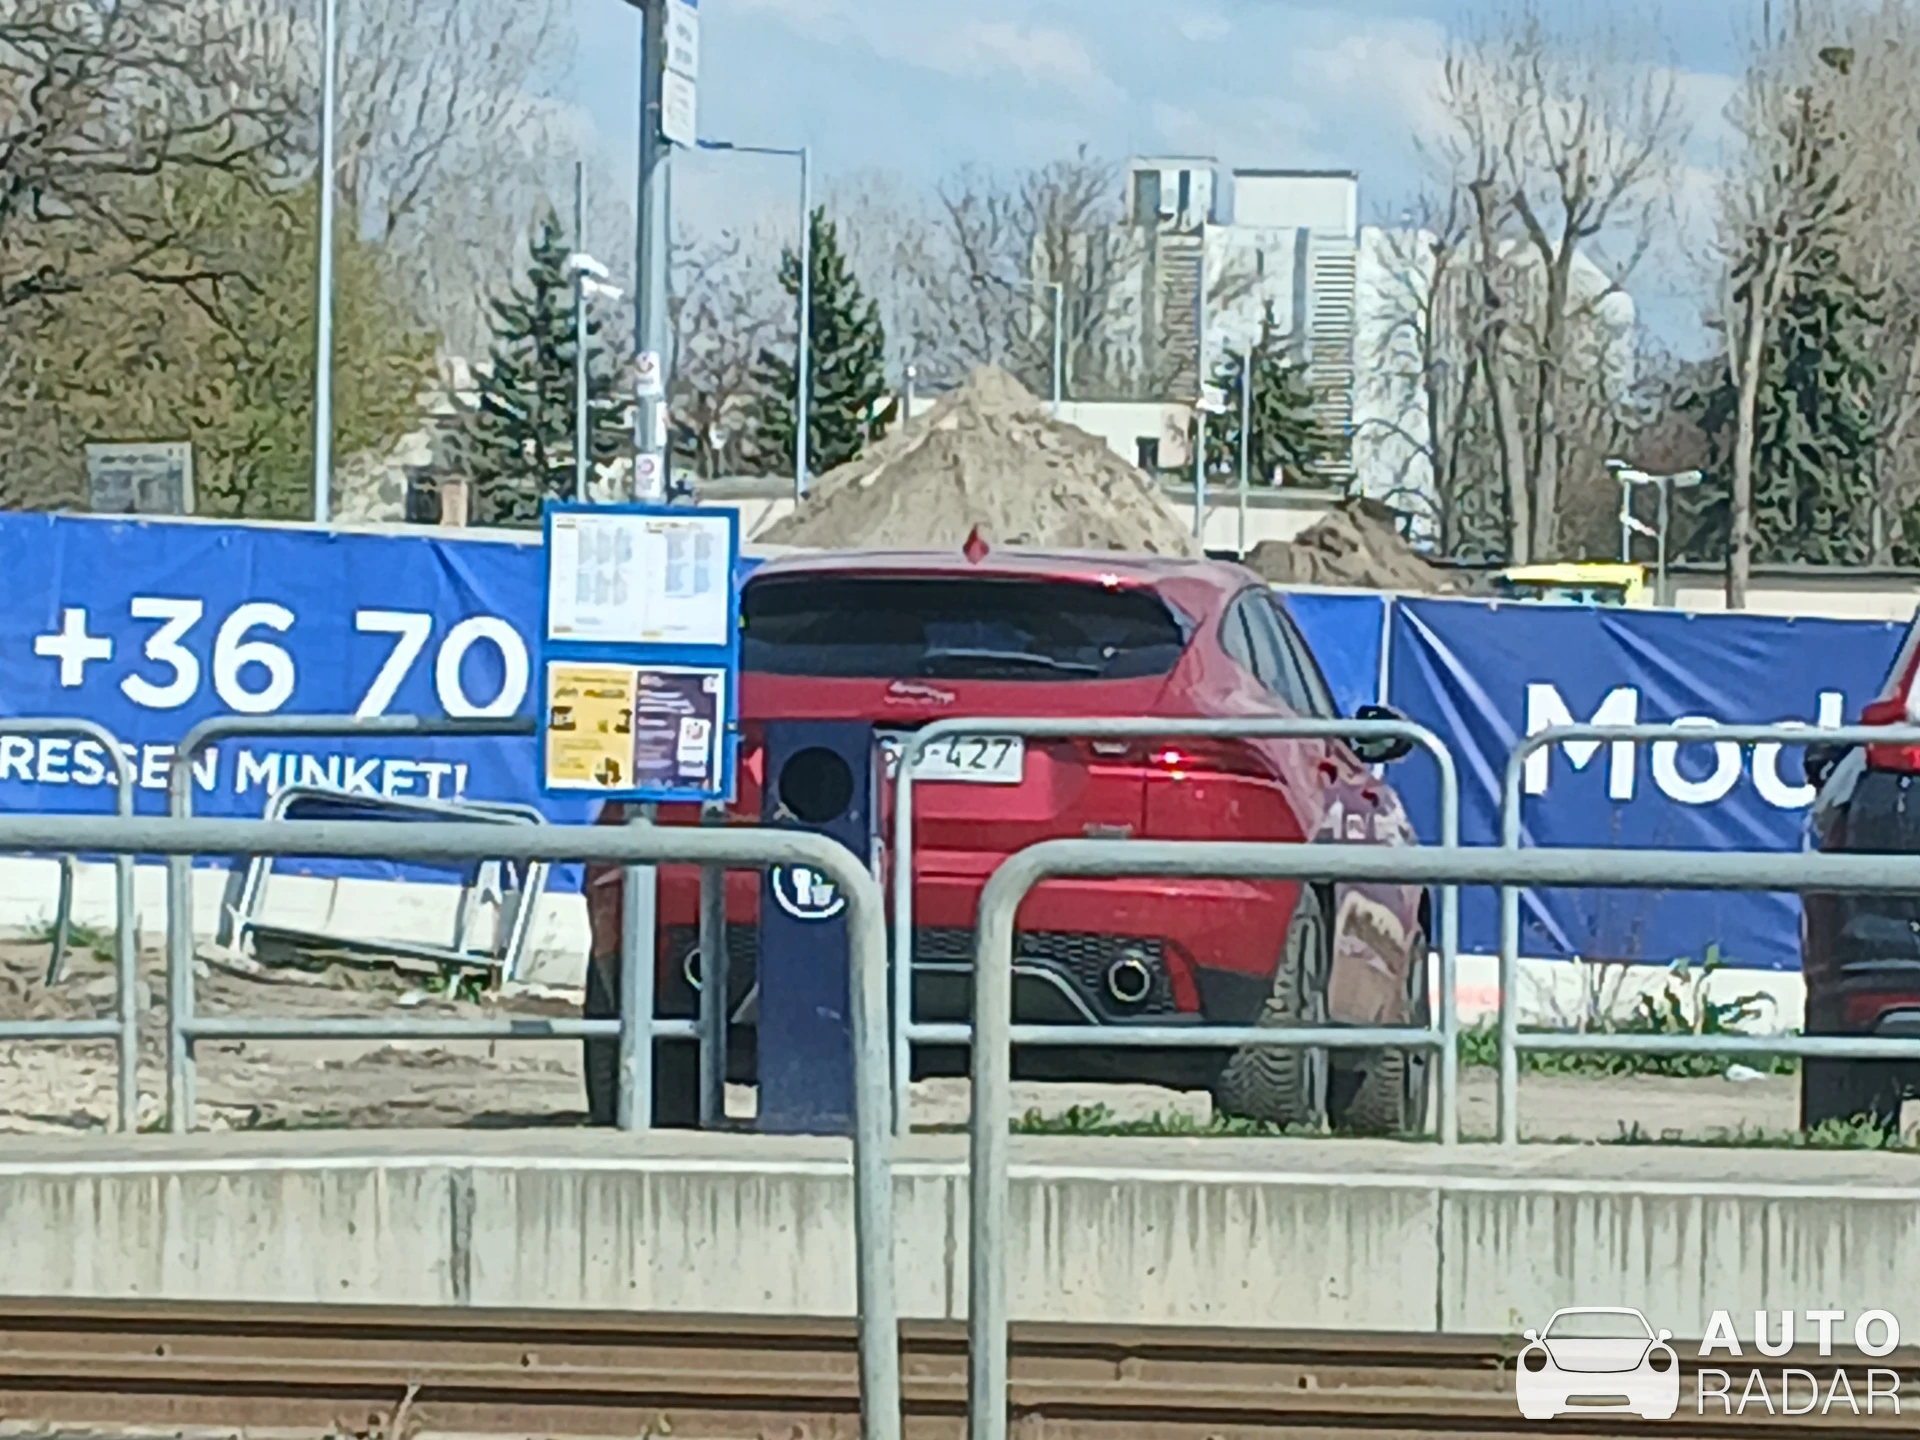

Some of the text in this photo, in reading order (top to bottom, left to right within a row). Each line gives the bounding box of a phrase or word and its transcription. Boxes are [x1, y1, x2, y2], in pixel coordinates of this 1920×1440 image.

[34, 597, 530, 720] +36 70
[235, 750, 468, 799] MINKET!
